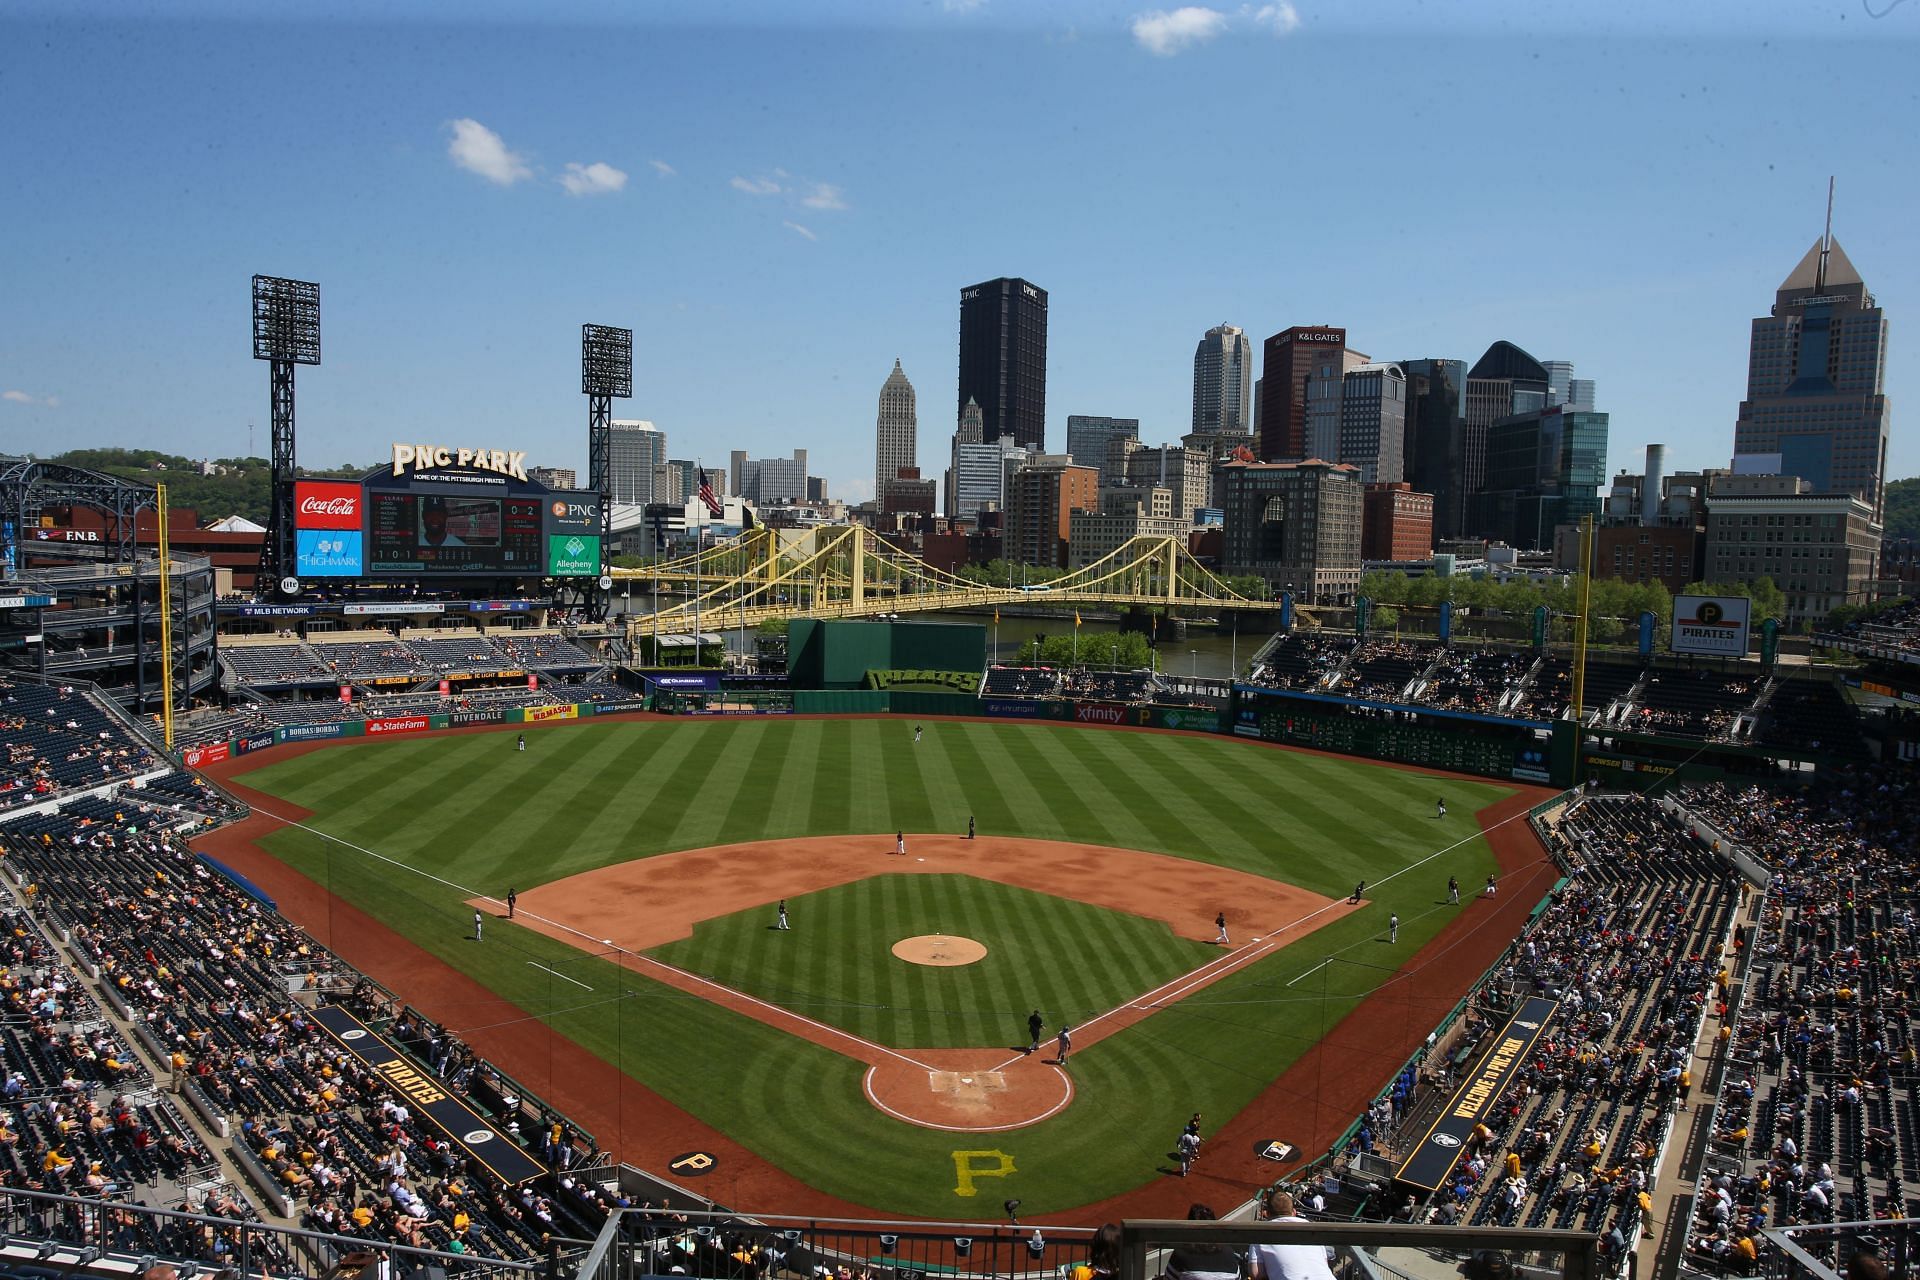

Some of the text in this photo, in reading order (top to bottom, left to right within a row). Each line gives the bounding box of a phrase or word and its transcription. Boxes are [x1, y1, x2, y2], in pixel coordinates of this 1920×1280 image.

[1023, 284, 1038, 299] UPMC
[1298, 333, 1340, 342] K&L GATES
[392, 443, 528, 482] PNC PARK
[301, 497, 357, 515] Coca-Cola
[568, 505, 597, 517] PNC
[66, 531, 100, 541] F.N.B.
[301, 555, 359, 566] HIGHMARK
[556, 560, 593, 569] Allegheny
[283, 580, 297, 590] Lite
[600, 577, 611, 587] Lite
[1704, 608, 1716, 621] P
[1682, 627, 1735, 640] PIRATES
[877, 669, 980, 691] PIRATES
[453, 712, 502, 722] RIVENDALE
[1078, 706, 1123, 723] xfinity
[1140, 709, 1151, 725] P
[289, 728, 314, 736] BORDAS
[248, 737, 272, 750] Fanatics
[1589, 757, 1620, 767] BOWSER
[1643, 764, 1675, 775] BLASTS
[377, 1060, 446, 1105] PIRATES
[1453, 1037, 1525, 1119] WELCOME TO PNC PARK
[671, 1153, 713, 1169] P
[951, 1149, 1018, 1197] P
